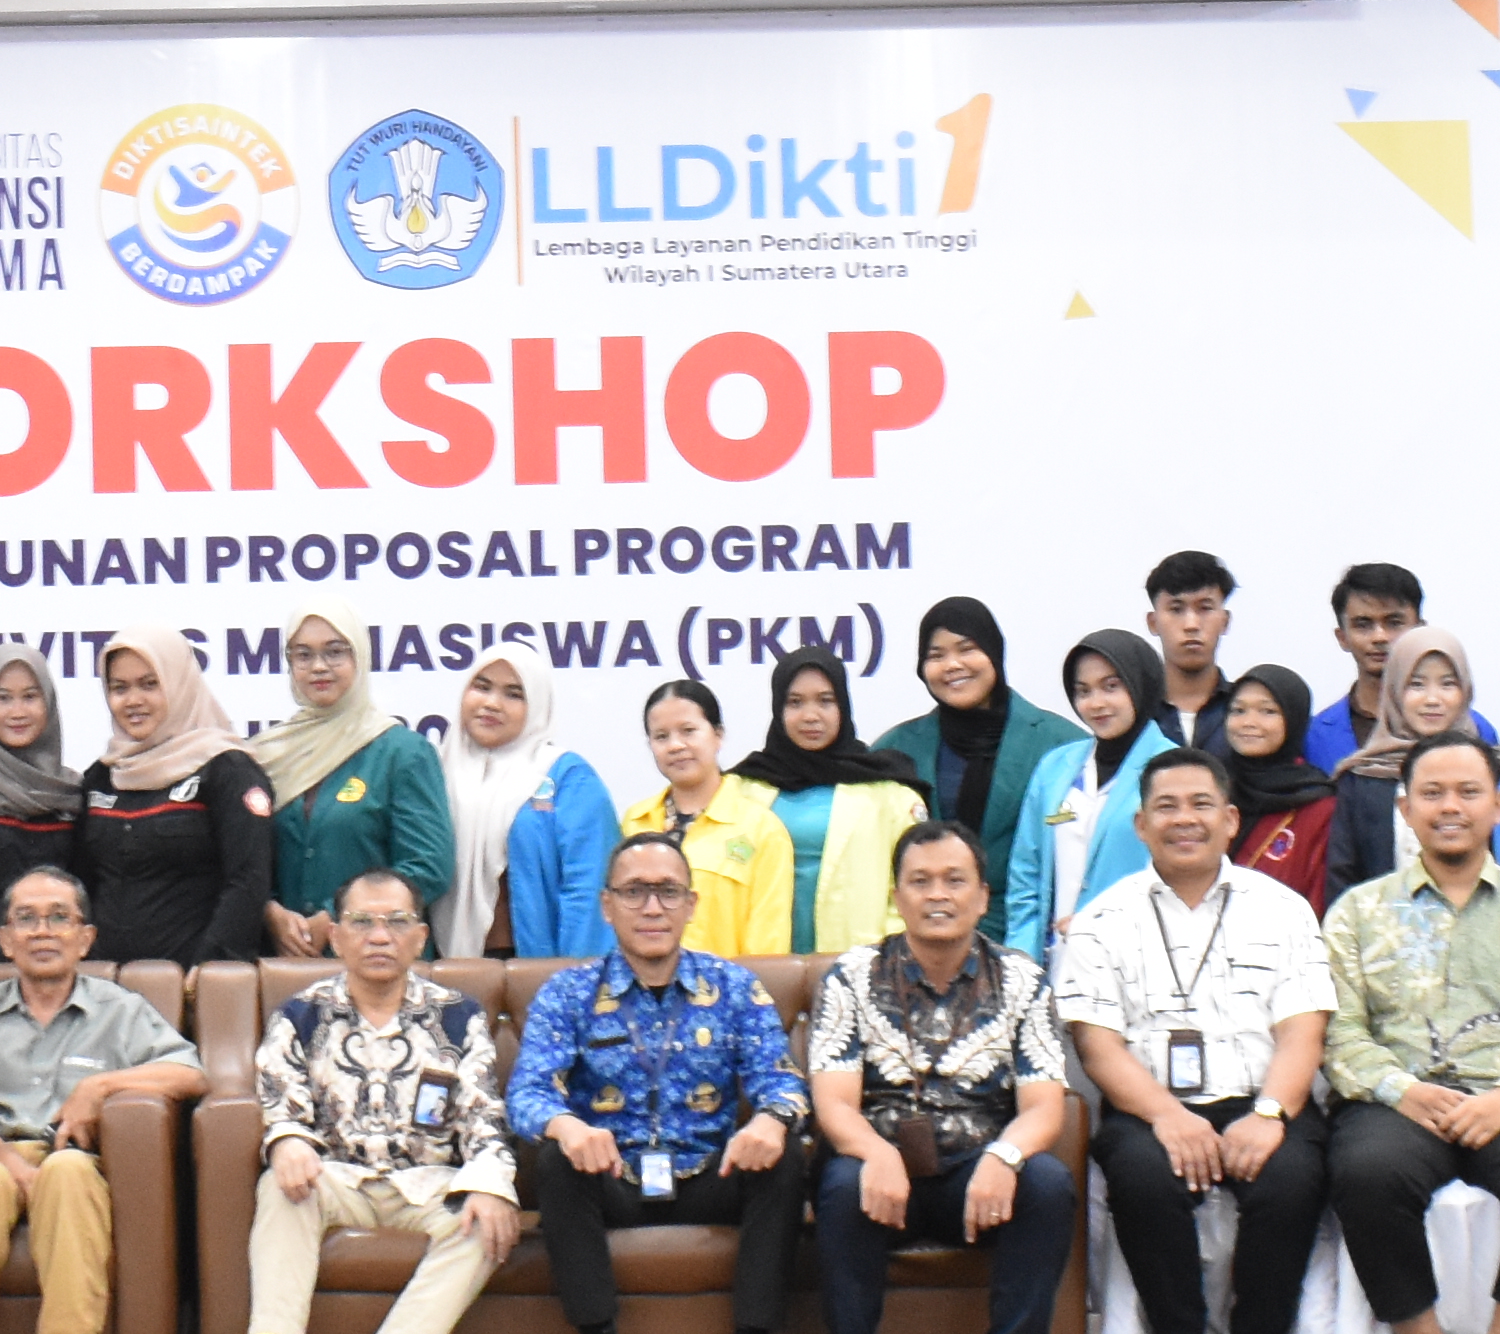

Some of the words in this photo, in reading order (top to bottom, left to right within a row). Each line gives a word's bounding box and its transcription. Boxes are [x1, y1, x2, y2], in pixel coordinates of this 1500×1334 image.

[111, 114, 283, 181] DIKTISAINTEK
[347, 142, 370, 171] TUT
[369, 122, 408, 146] WURI
[412, 121, 488, 172] HANDAYANI
[119, 240, 280, 296] BERDAMPAK
[534, 238, 645, 259] Lembaga
[652, 237, 752, 257] Layanan
[760, 232, 895, 251] Pendidikan
[902, 230, 977, 252] Tinggi
[604, 265, 700, 287] Wilayah
[721, 264, 837, 281] Sumatera
[844, 262, 909, 278] Utara
[205, 529, 559, 583] PROPOSAL
[573, 522, 912, 576] PROGRAM
